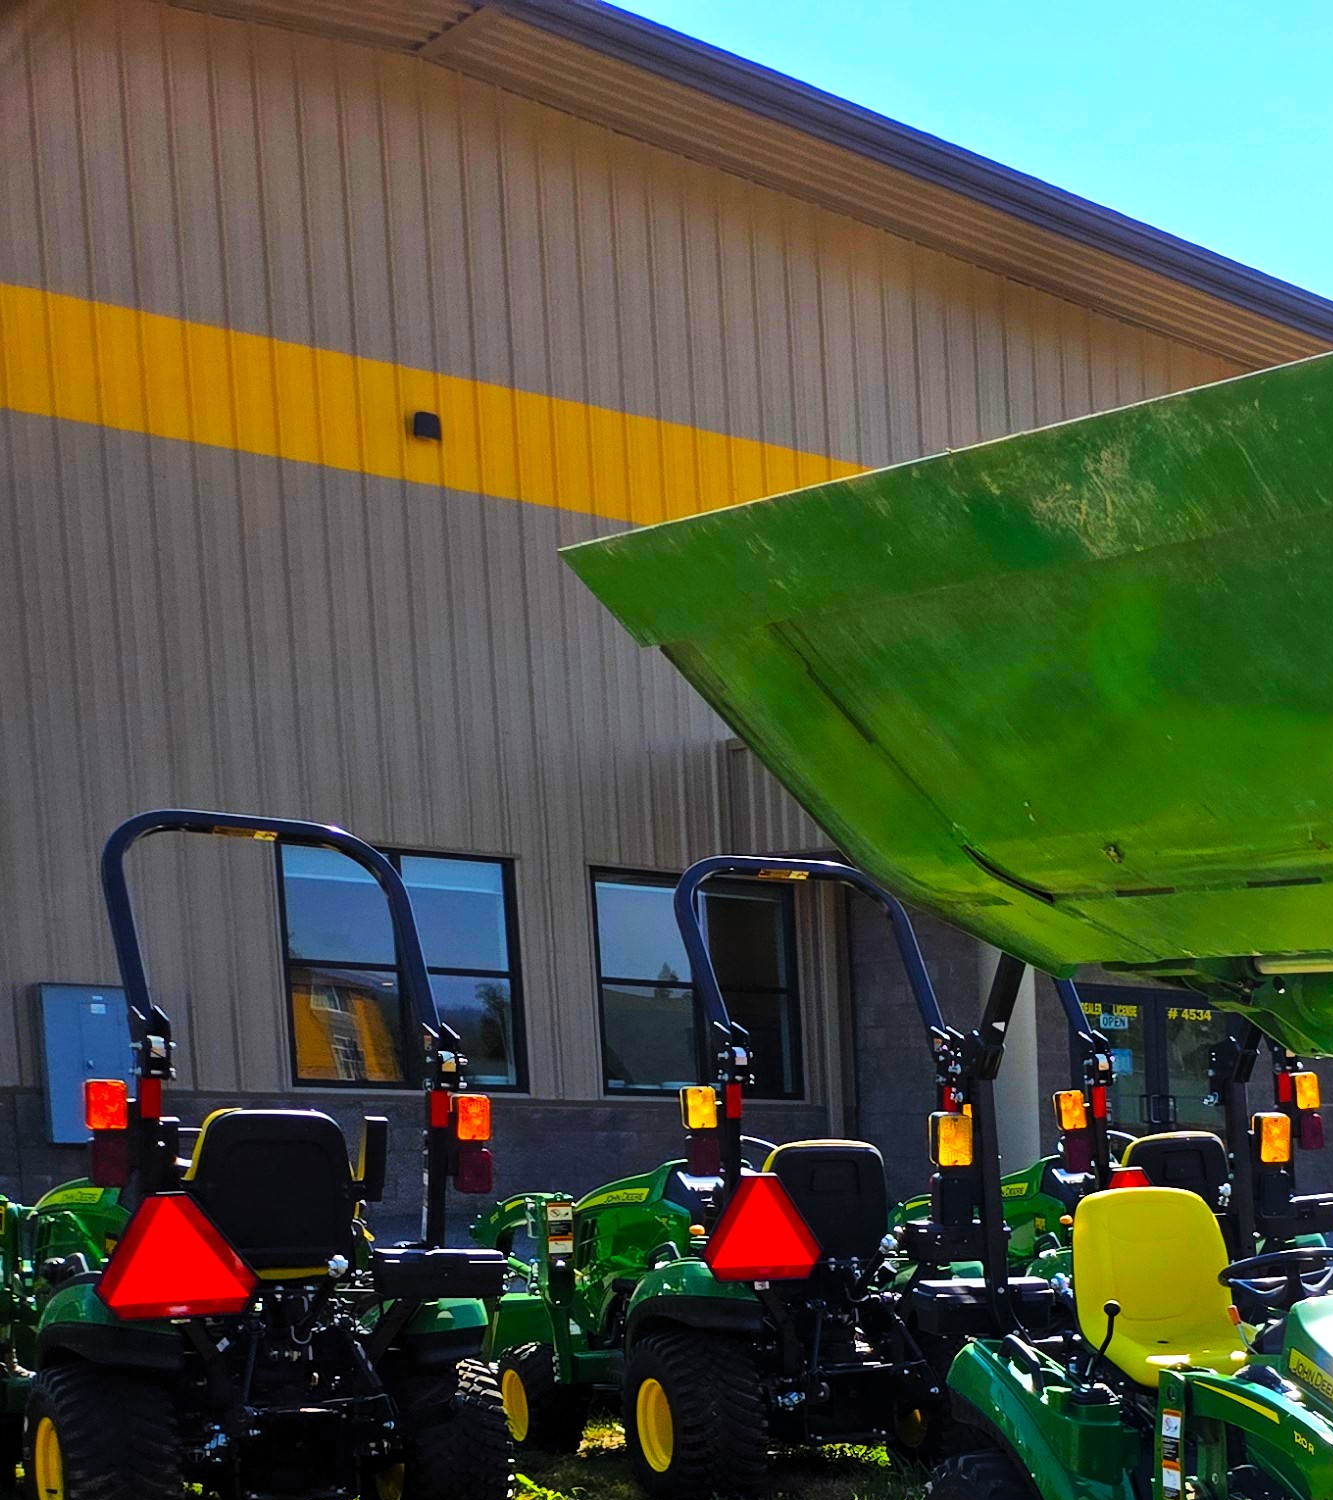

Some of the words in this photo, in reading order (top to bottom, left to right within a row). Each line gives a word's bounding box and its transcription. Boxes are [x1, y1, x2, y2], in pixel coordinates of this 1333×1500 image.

[1112, 1004, 1138, 1017] LICENSE
[1181, 1008, 1212, 1021] 4534
[1102, 1015, 1126, 1028] OPEN
[1293, 1359, 1315, 1383] JOHN
